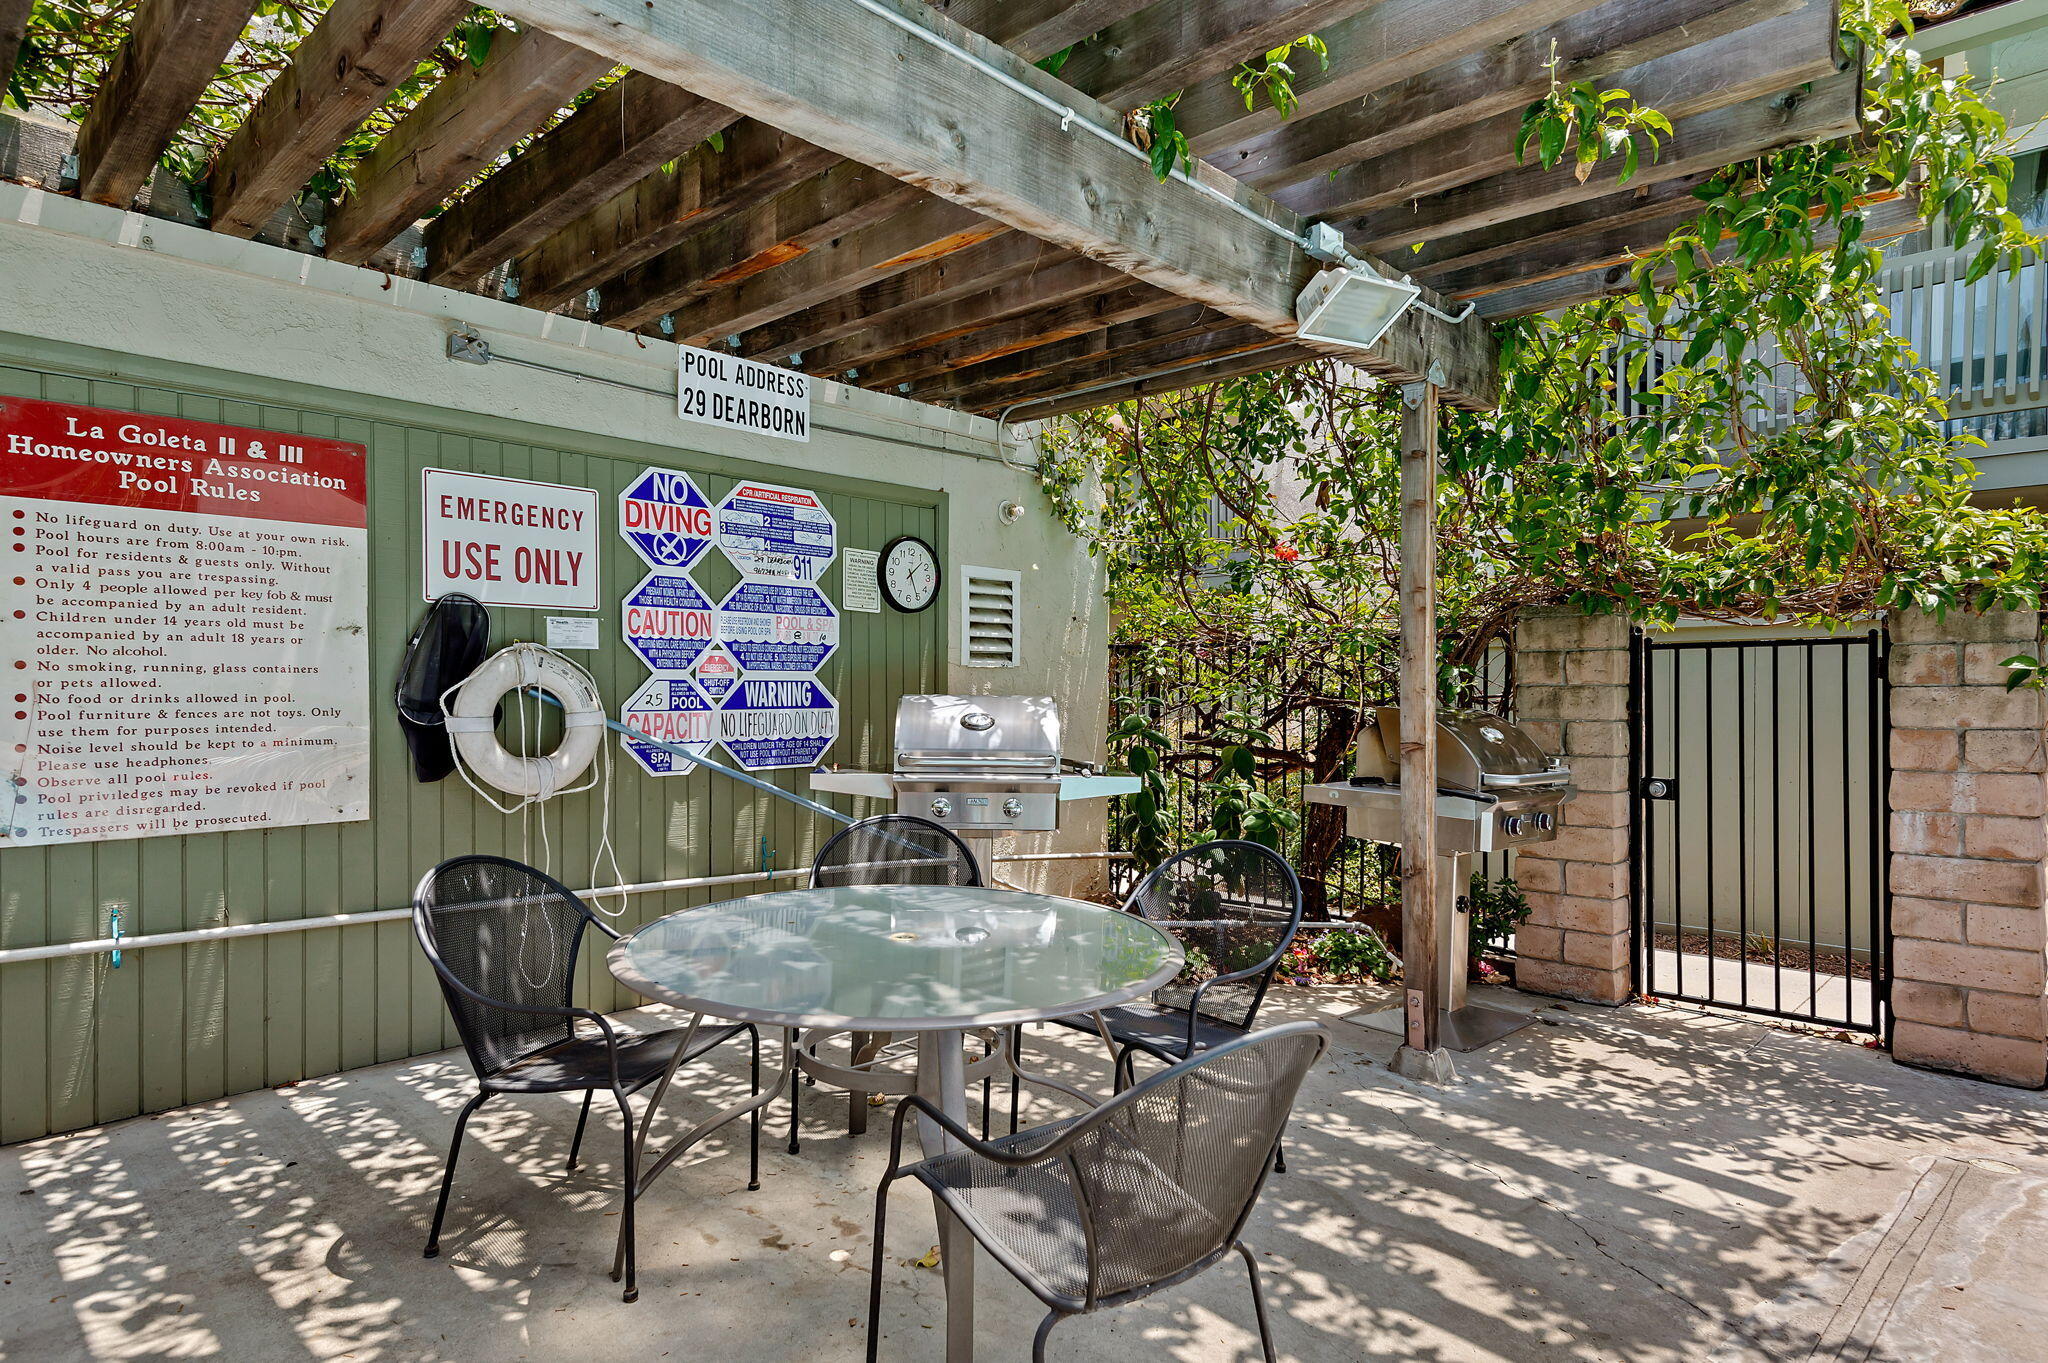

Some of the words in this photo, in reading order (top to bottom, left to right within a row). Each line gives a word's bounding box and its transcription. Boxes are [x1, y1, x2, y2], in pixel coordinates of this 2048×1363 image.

[685, 352, 727, 381] POOL
[735, 367, 804, 398] ADDRESS
[683, 388, 706, 416] 29
[713, 394, 805, 437] DEARBORN
[66, 417, 104, 439] La
[119, 425, 207, 452] Goleta
[247, 441, 267, 460] &
[8, 435, 193, 472] Homeowners
[205, 458, 347, 490] Association
[119, 471, 177, 494] Pool
[191, 478, 261, 502] Rules
[653, 473, 688, 504] NO
[441, 495, 584, 532] EMERGENCY
[625, 500, 711, 536] DIVING
[35, 511, 59, 524] No
[65, 513, 138, 530] lifeguard
[144, 523, 161, 534] on
[167, 522, 202, 538] duty.
[207, 525, 233, 538] Use
[238, 530, 250, 539] at
[255, 532, 286, 542] your
[290, 535, 316, 545] own
[321, 536, 350, 549] risk.
[35, 528, 70, 541] Pool
[76, 530, 120, 545] hours
[126, 537, 150, 547] are
[156, 537, 190, 550] from
[195, 540, 246, 554] 8:00am
[262, 545, 302, 559] 10:pm.
[908, 548, 915, 556] 12
[35, 544, 70, 558] Pool
[76, 547, 99, 559] for
[105, 551, 172, 564] residents
[178, 554, 189, 565] &
[195, 558, 239, 568] guests
[244, 559, 275, 572] only.
[280, 561, 331, 575] Without
[442, 541, 501, 582] USE
[514, 546, 583, 587] ONLY
[793, 556, 812, 580] 911
[35, 564, 44, 572] a
[51, 563, 91, 575] valid
[97, 567, 131, 578] pass
[137, 570, 163, 580] you
[169, 572, 192, 580] are
[197, 572, 279, 588] trespassing.
[35, 577, 75, 592] Only
[82, 580, 92, 591] 4
[99, 582, 148, 596] people
[153, 584, 208, 597] allowed
[213, 589, 236, 600] per
[240, 588, 263, 602] key
[266, 589, 288, 601] fob
[289, 591, 302, 602] &
[304, 594, 333, 605] must
[35, 594, 55, 606] be
[61, 598, 159, 610] accompanied
[164, 599, 182, 613] by
[186, 602, 206, 613] an
[211, 602, 246, 613] adult
[251, 604, 307, 616] resident.
[35, 610, 107, 624] Children
[113, 614, 157, 625] under
[163, 615, 178, 626] 14
[184, 619, 221, 629] years
[226, 617, 247, 628] old
[252, 621, 284, 630] must
[289, 620, 305, 630] be
[628, 608, 711, 637] CAUTION
[776, 616, 805, 630] POOL
[36, 630, 136, 642] accompanied
[142, 630, 160, 644] by
[166, 634, 184, 642] an
[190, 632, 226, 643] adult
[231, 633, 245, 643] 18
[250, 632, 285, 646] years
[290, 637, 306, 645] or
[36, 644, 79, 656] older.
[86, 644, 108, 656] No
[112, 645, 168, 657] alcohol.
[36, 660, 60, 672] No
[67, 661, 137, 675] smoking,
[143, 662, 207, 675] running,
[212, 662, 247, 676] glass
[252, 664, 319, 674] containers
[36, 680, 53, 689] or
[60, 679, 94, 691] pets
[100, 677, 162, 688] allowed.
[745, 682, 812, 707] WARNING
[36, 693, 61, 707] No
[67, 693, 102, 707] food
[108, 696, 124, 704] or
[130, 693, 180, 704] drinks
[186, 692, 239, 704] allowed
[244, 693, 258, 703] in
[263, 693, 296, 705] pool.
[672, 697, 703, 709] POOL
[37, 709, 71, 721] Pool
[78, 709, 151, 721] furniture
[157, 708, 169, 720] &
[174, 708, 218, 719] fences
[223, 710, 245, 718] are
[250, 709, 271, 718] not
[276, 709, 306, 720] toys.
[311, 707, 342, 719] Only
[627, 713, 714, 740] CAPACITY
[721, 713, 735, 737] NO
[740, 712, 792, 737] LIFEGUARD
[795, 712, 807, 734] ON
[811, 711, 834, 735] DUTY
[651, 753, 670, 763] SPA
[732, 742, 757, 750] CHILDREN
